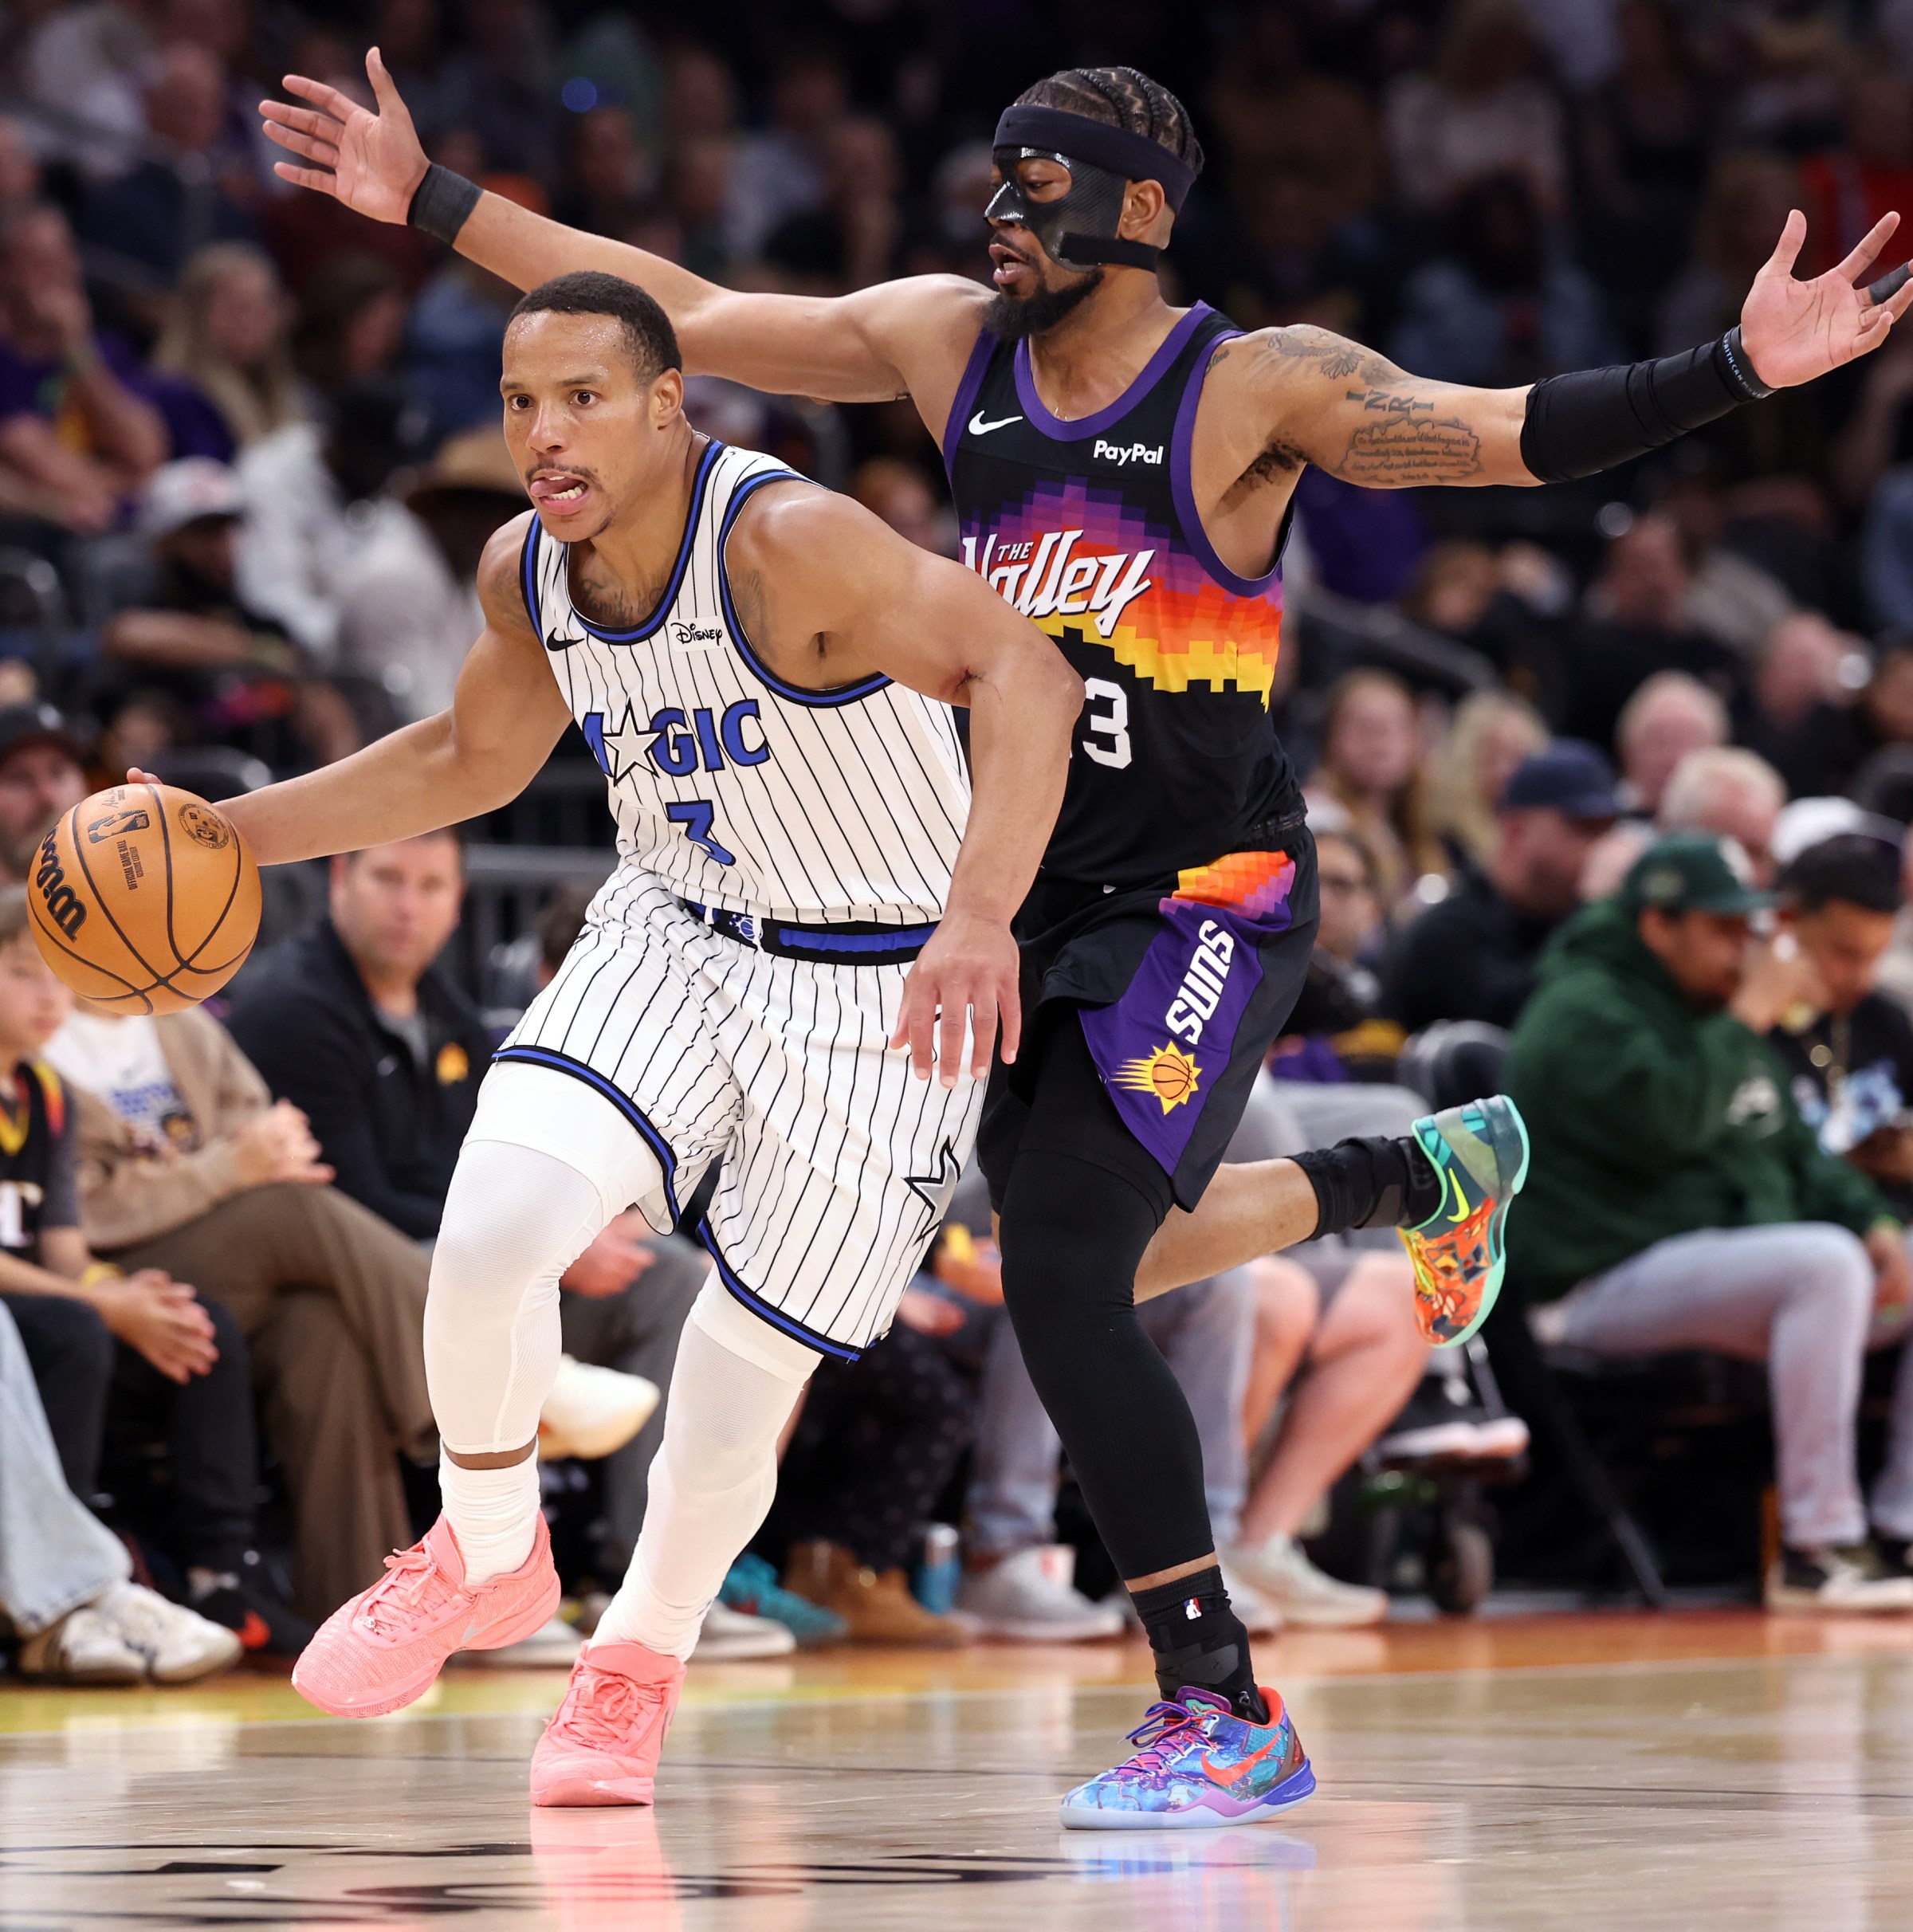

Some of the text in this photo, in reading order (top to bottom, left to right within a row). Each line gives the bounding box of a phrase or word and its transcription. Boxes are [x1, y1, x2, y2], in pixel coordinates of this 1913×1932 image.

[1722, 339, 1735, 364] FAITH
[1731, 363, 1743, 380] CAN
[1093, 440, 1164, 466] PayPal
[997, 540, 1035, 562] THE
[962, 529, 1156, 638] Valley
[666, 799, 736, 866] 3
[116, 839, 138, 890] OFFICIAL GAME BALL
[1165, 920, 1235, 1046] SUNS
